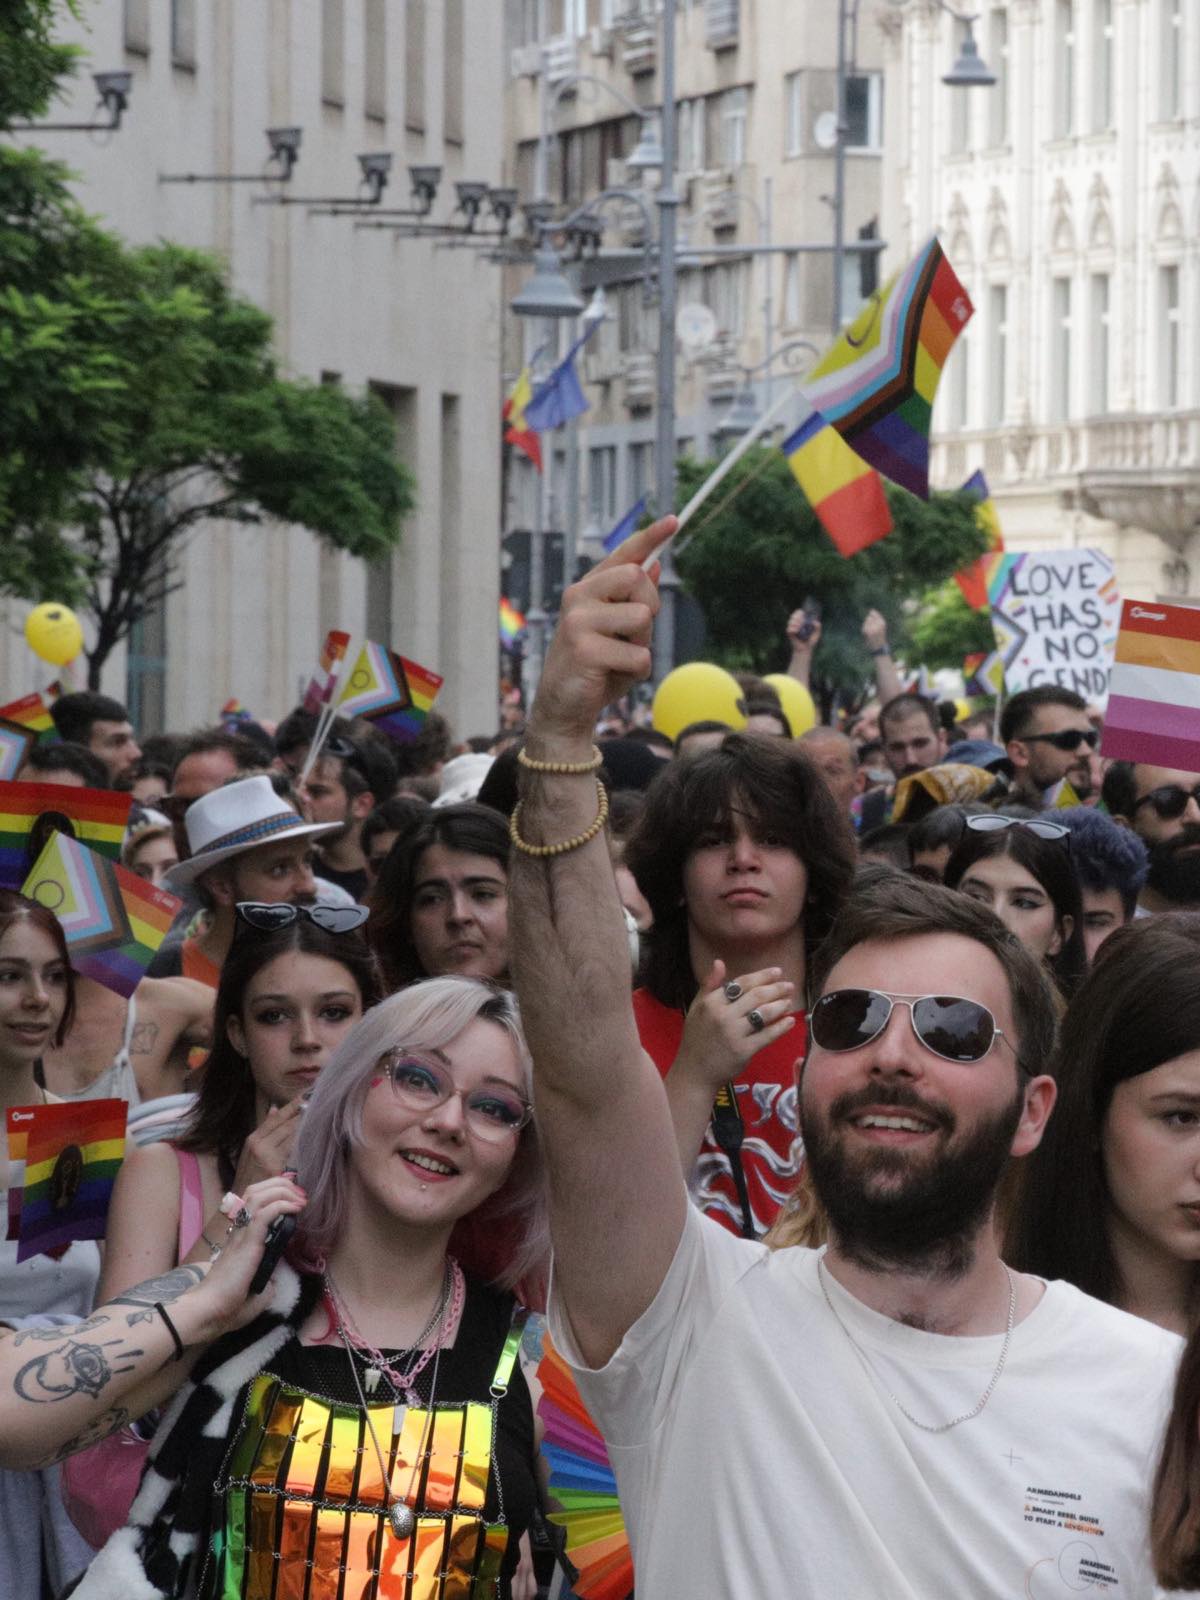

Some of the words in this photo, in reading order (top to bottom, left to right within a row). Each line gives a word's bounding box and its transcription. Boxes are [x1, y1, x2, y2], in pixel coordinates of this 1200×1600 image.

[1008, 562, 1096, 596] LOVE
[1030, 598, 1102, 632] HAS
[1045, 632, 1098, 662] NO
[1028, 667, 1112, 696] GEND
[1032, 1506, 1056, 1517] SMART
[1079, 1515, 1100, 1525] GUIDE
[1035, 1517, 1057, 1526] START
